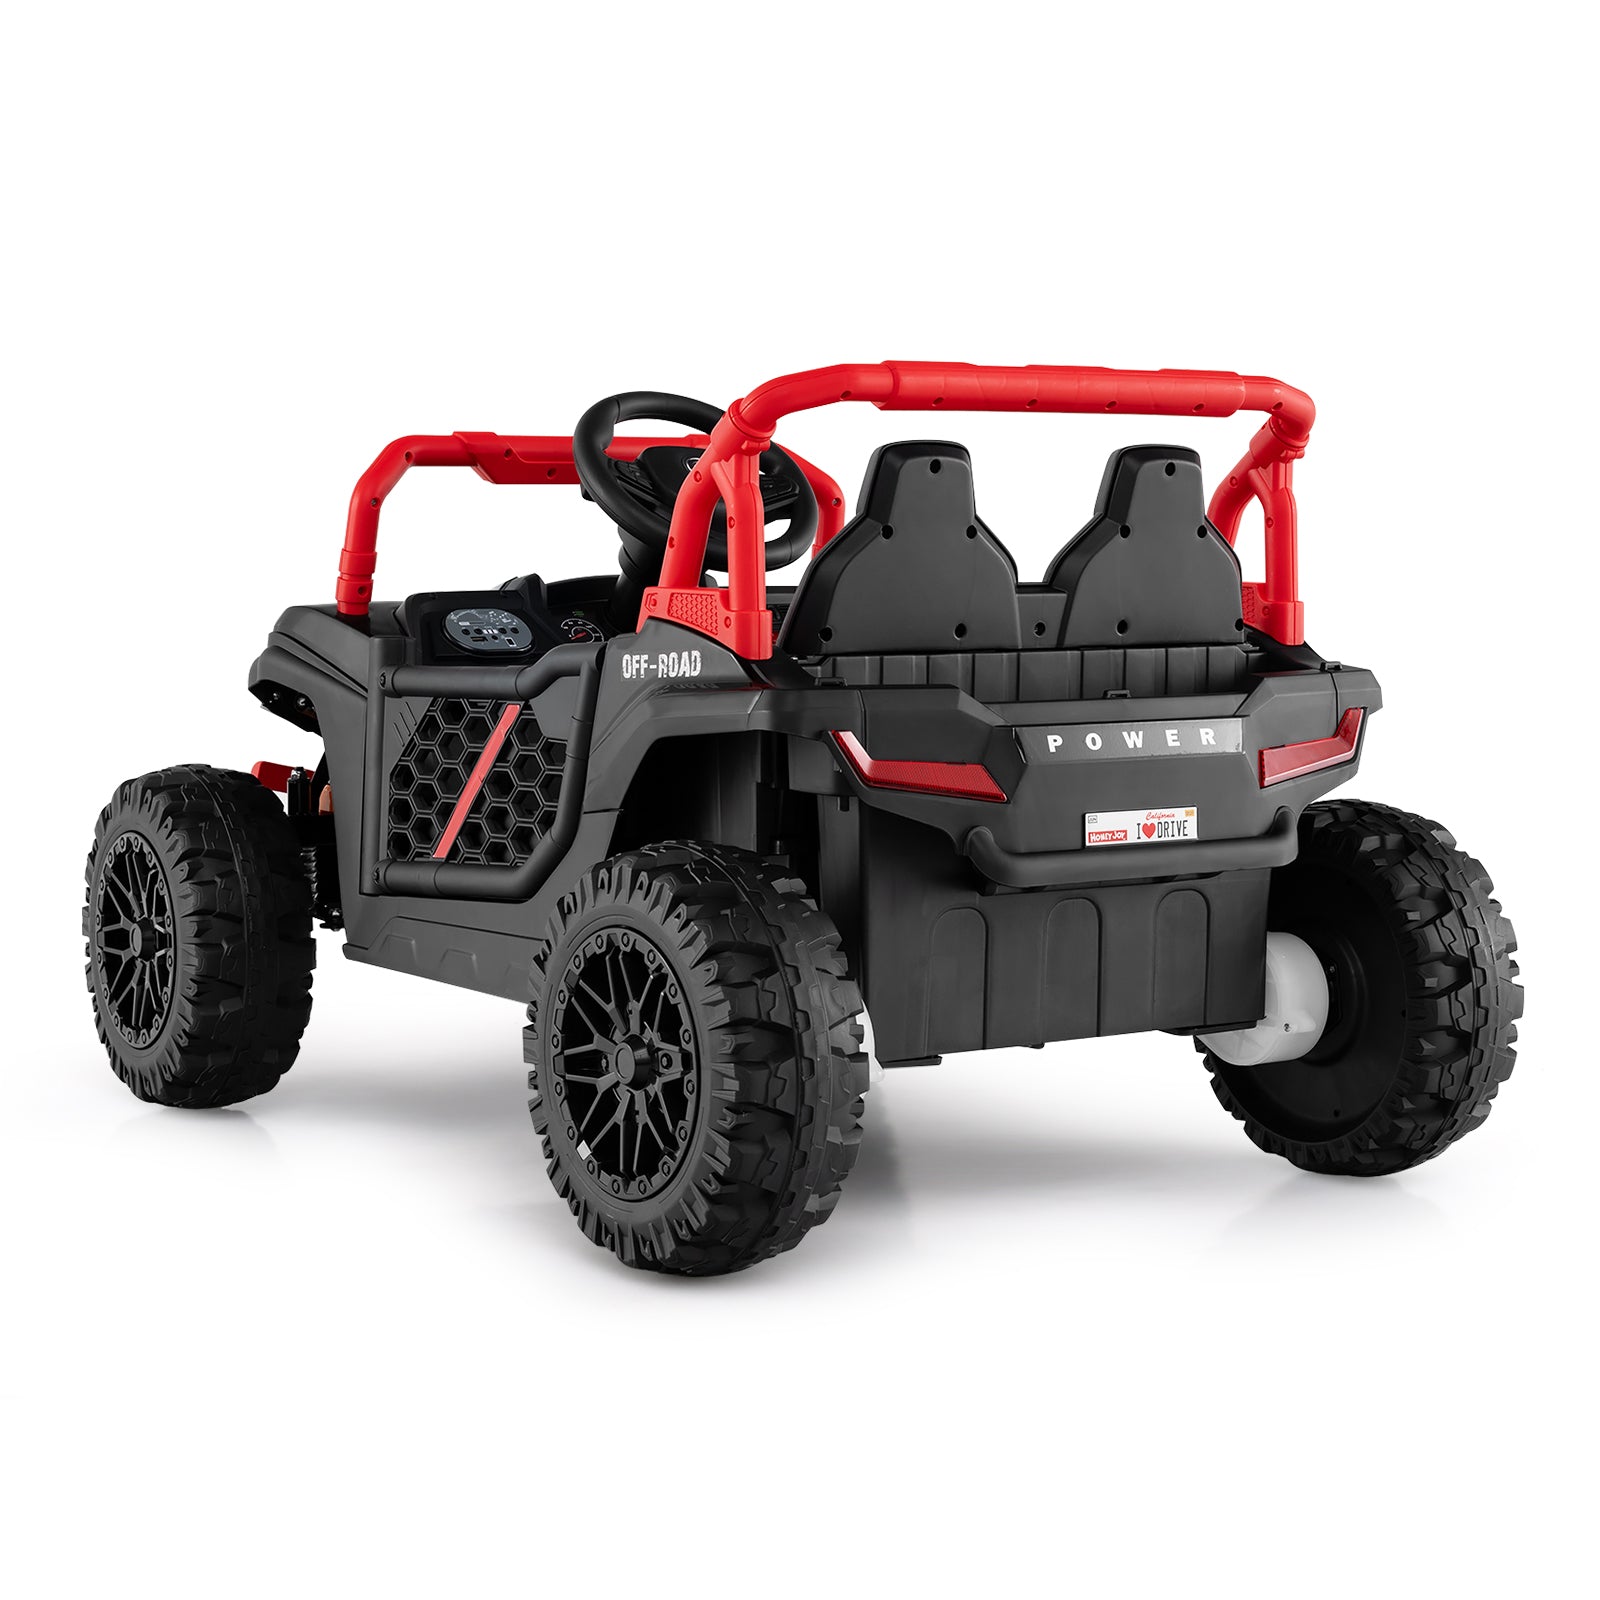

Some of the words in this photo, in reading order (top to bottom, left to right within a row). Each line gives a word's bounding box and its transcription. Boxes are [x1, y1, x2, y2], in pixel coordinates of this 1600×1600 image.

[622, 650, 702, 679] OFF-ROAD
[1047, 728, 1216, 753] POWER
[1145, 811, 1176, 821] California
[1136, 823, 1141, 840] I
[1157, 820, 1188, 838] DRIVE
